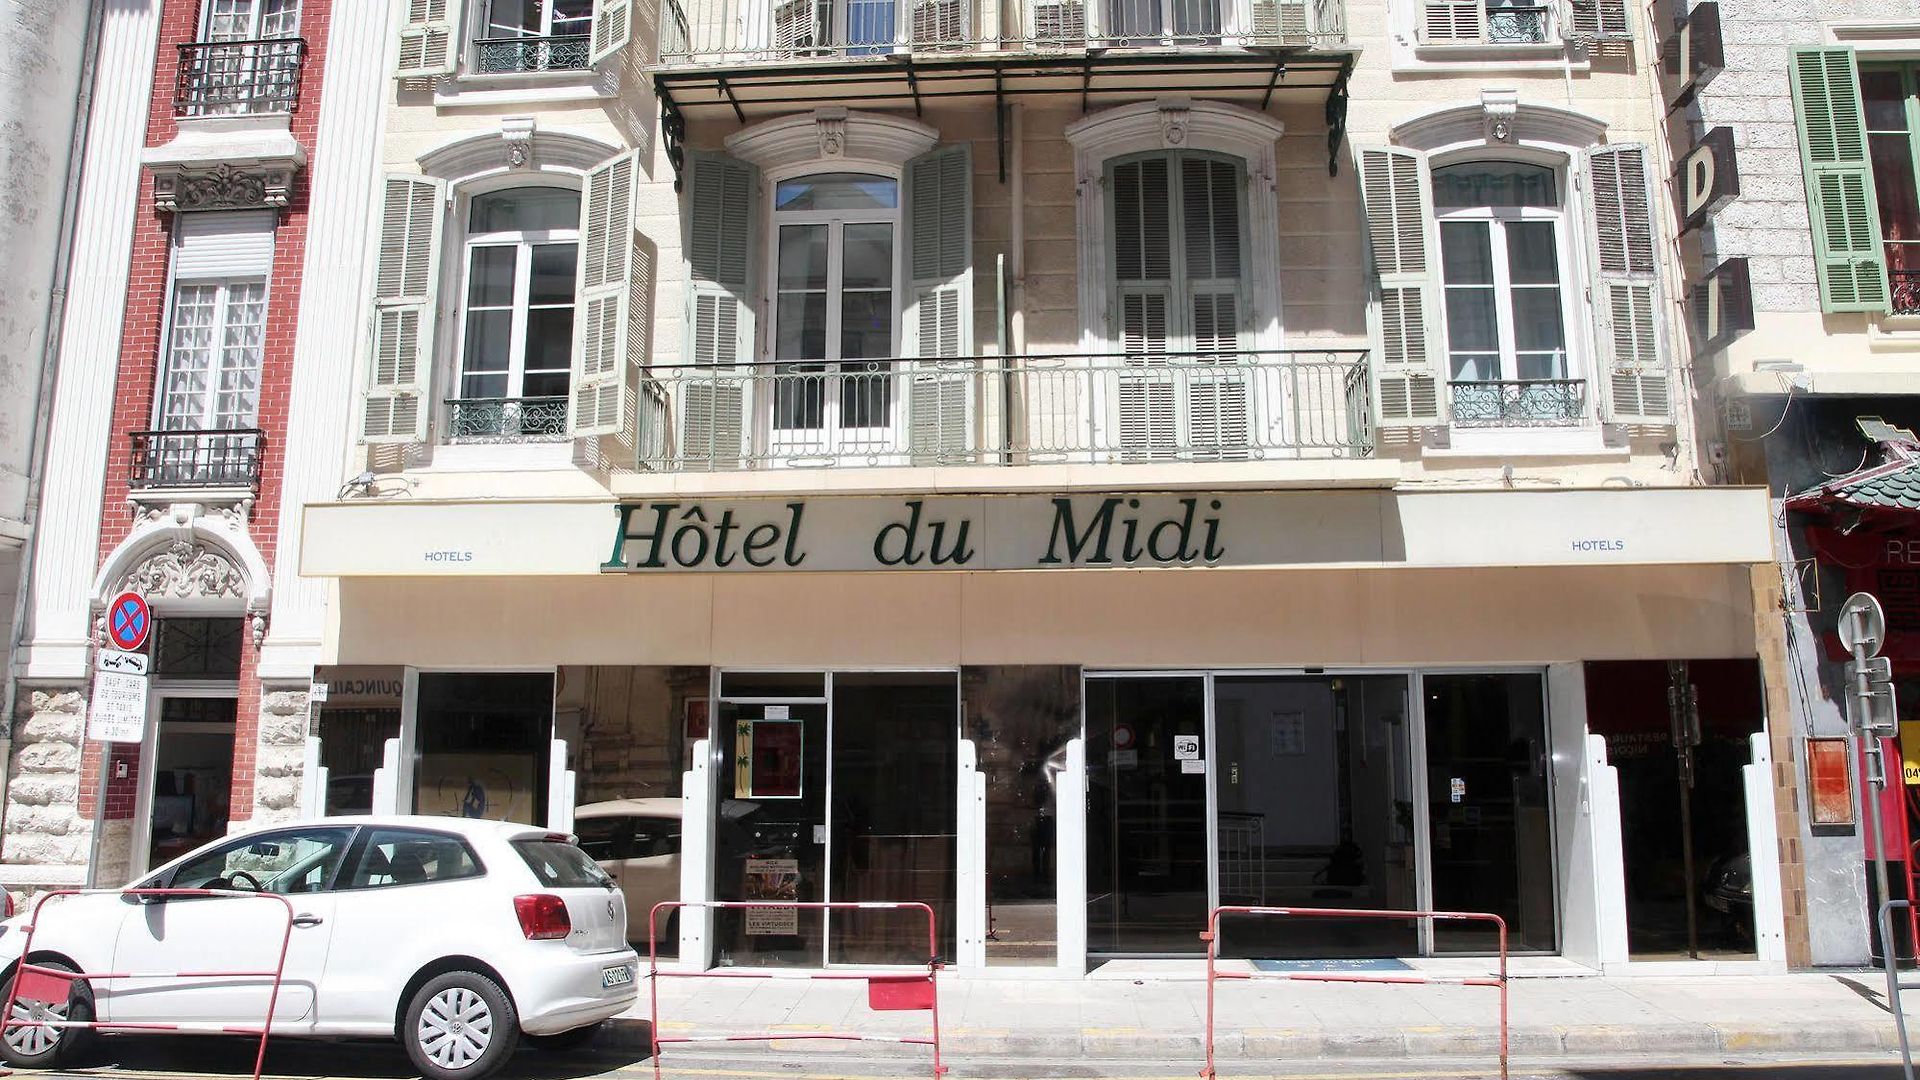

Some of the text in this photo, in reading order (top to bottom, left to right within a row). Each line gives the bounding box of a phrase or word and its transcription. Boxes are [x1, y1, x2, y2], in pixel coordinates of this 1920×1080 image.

[601, 498, 1225, 568] Hôtel du Midi
[1572, 540, 1624, 551] HOTELS
[425, 551, 473, 562] HOTELS
[1905, 767, 1920, 779] 04
